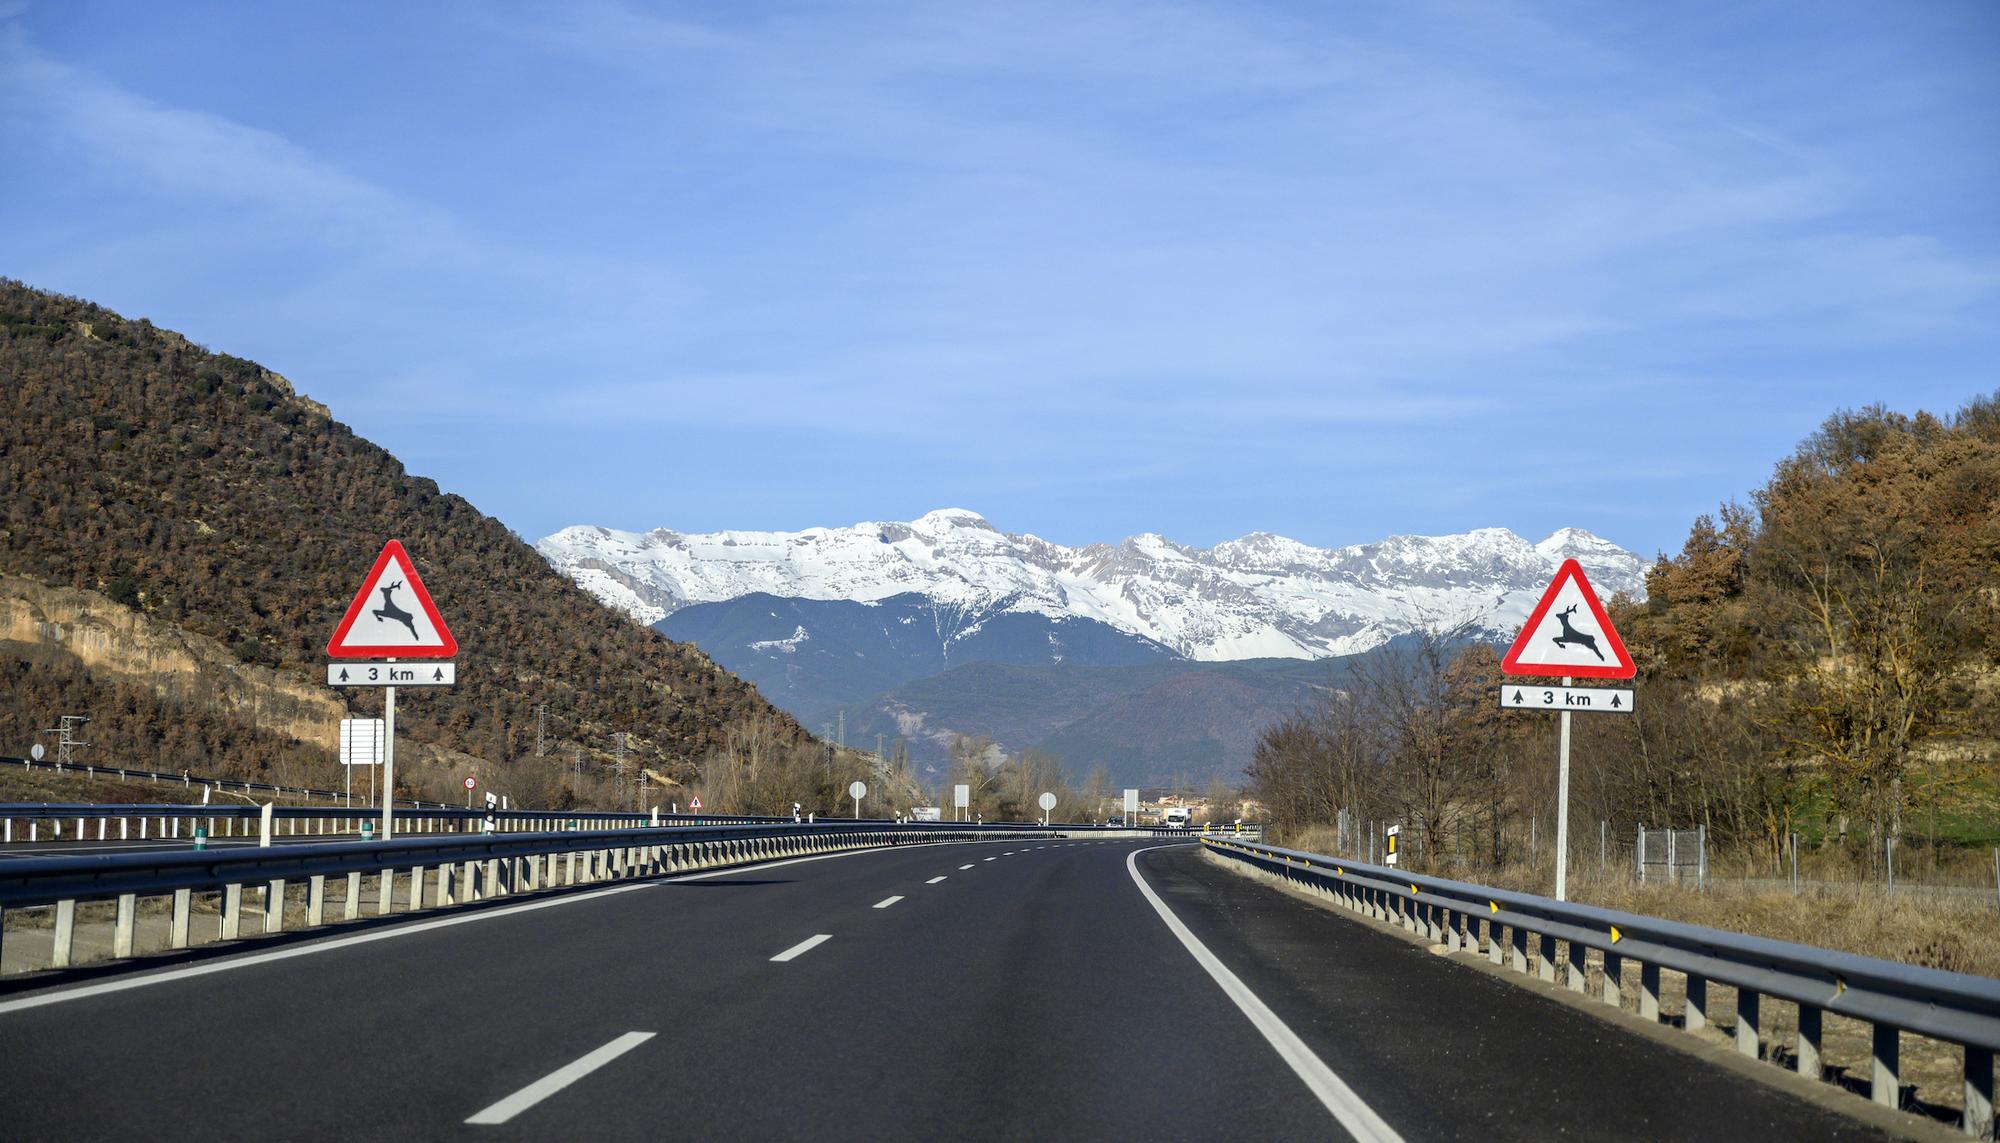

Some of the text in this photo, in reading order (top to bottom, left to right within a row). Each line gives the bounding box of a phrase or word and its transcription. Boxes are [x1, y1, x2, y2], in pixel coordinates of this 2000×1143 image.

[368, 667, 414, 681] 3 km
[1544, 691, 1591, 706] 3 km
